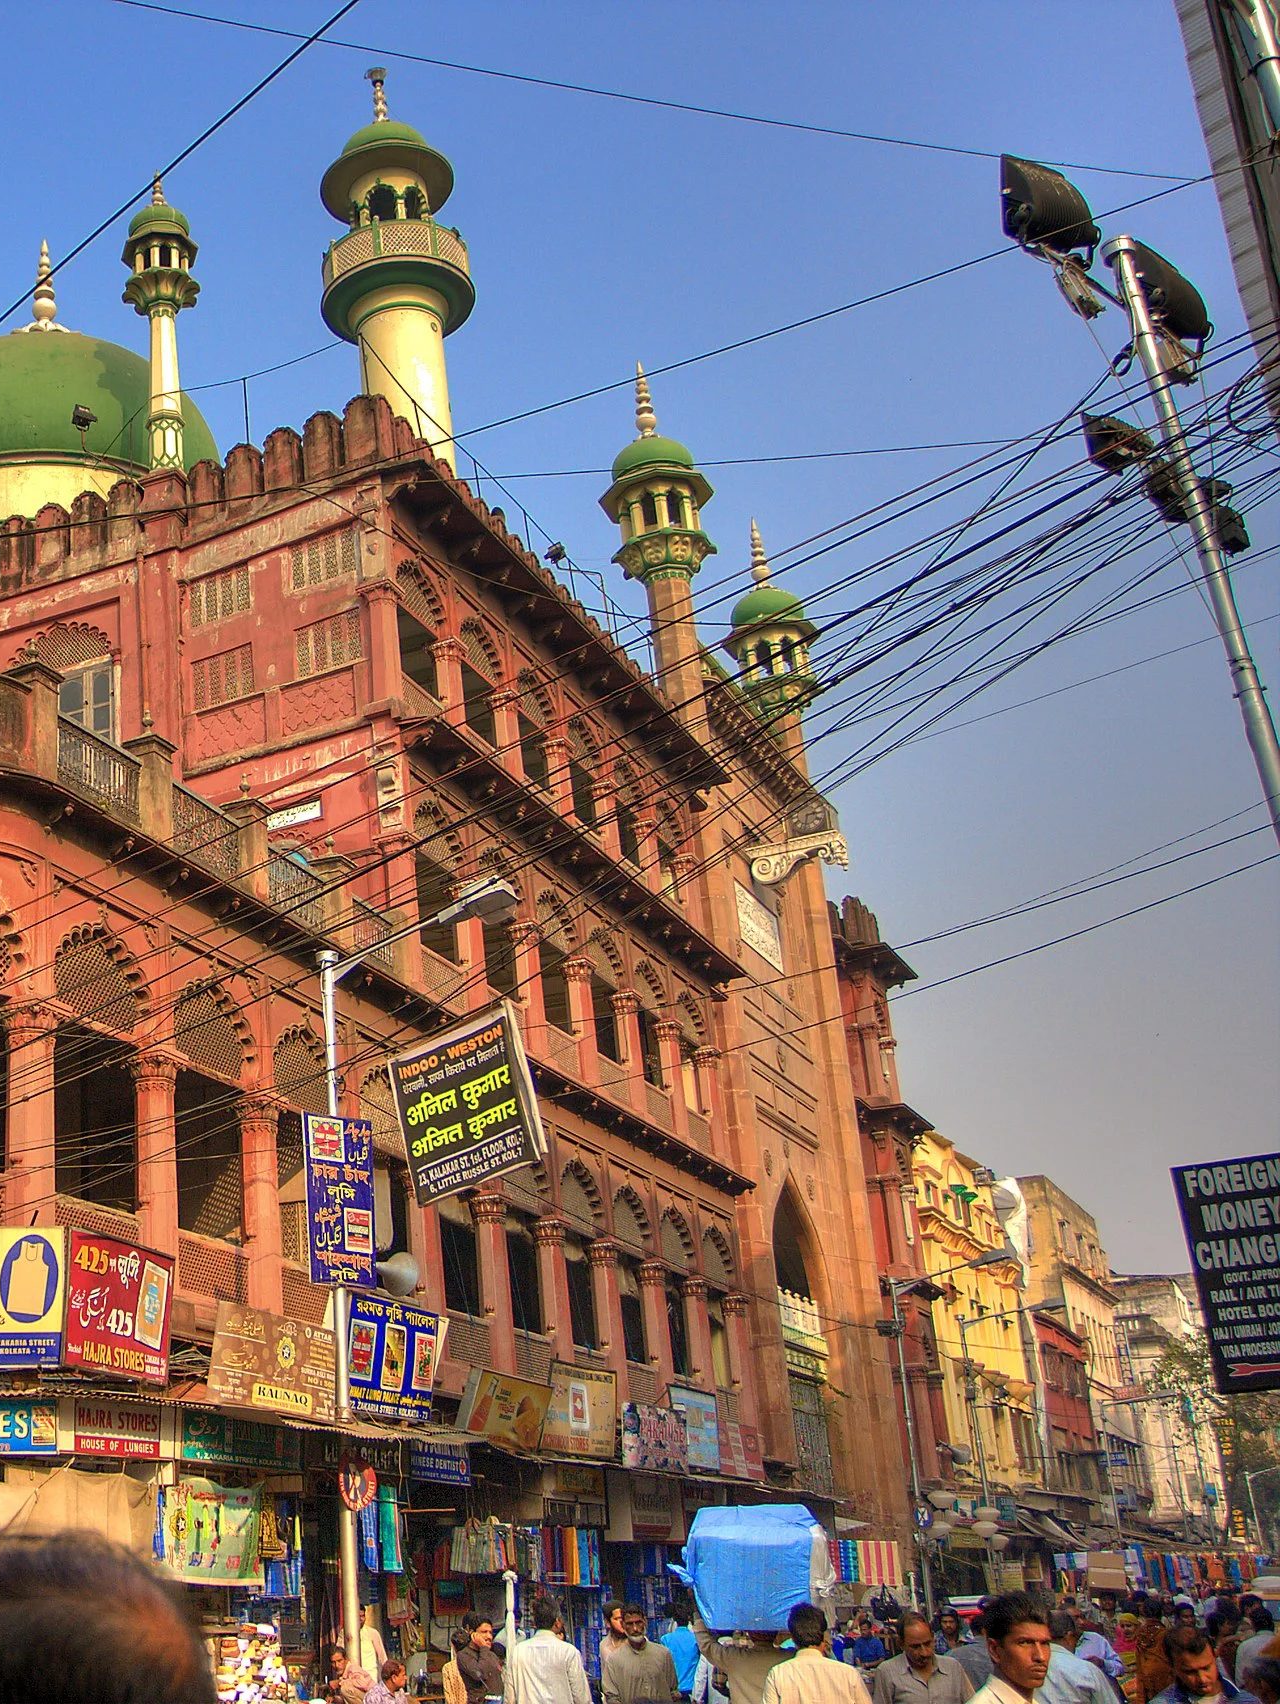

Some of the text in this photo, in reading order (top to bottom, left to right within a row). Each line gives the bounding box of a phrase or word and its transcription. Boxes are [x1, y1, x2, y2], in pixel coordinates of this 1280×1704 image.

[398, 1055, 439, 1080] INDOO
[446, 1024, 504, 1058] WESTON
[406, 1064, 512, 1126] अनिल कुमार
[411, 1098, 518, 1158] अजित कुमार
[429, 1160, 460, 1181] KALAKAR
[438, 1173, 463, 1191] LITTLE
[462, 1163, 490, 1183] RUSSLE
[1183, 1159, 1280, 1198] FOREIGN
[1200, 1196, 1280, 1233] MONEY
[74, 1245, 109, 1275] 425
[1210, 1288, 1238, 1303] RAIL
[1246, 1285, 1268, 1300] AIR
[356, 1300, 384, 1316] রহমত
[1217, 1305, 1258, 1321] HOTEL
[106, 1308, 133, 1337] 425
[0, 1347, 46, 1355] KOLKATA 73
[83, 1341, 145, 1372] HAJRA STORES
[1220, 1344, 1241, 1358] VISA
[258, 1386, 308, 1407] RAUNAQ
[78, 1406, 158, 1433] HAJRA STORES
[640, 1418, 685, 1444] PARADISE
[80, 1438, 154, 1454] HOUSE OF LUNGIES
[203, 1452, 234, 1461] ZAKARIA
[435, 1458, 459, 1472] DENTIST
